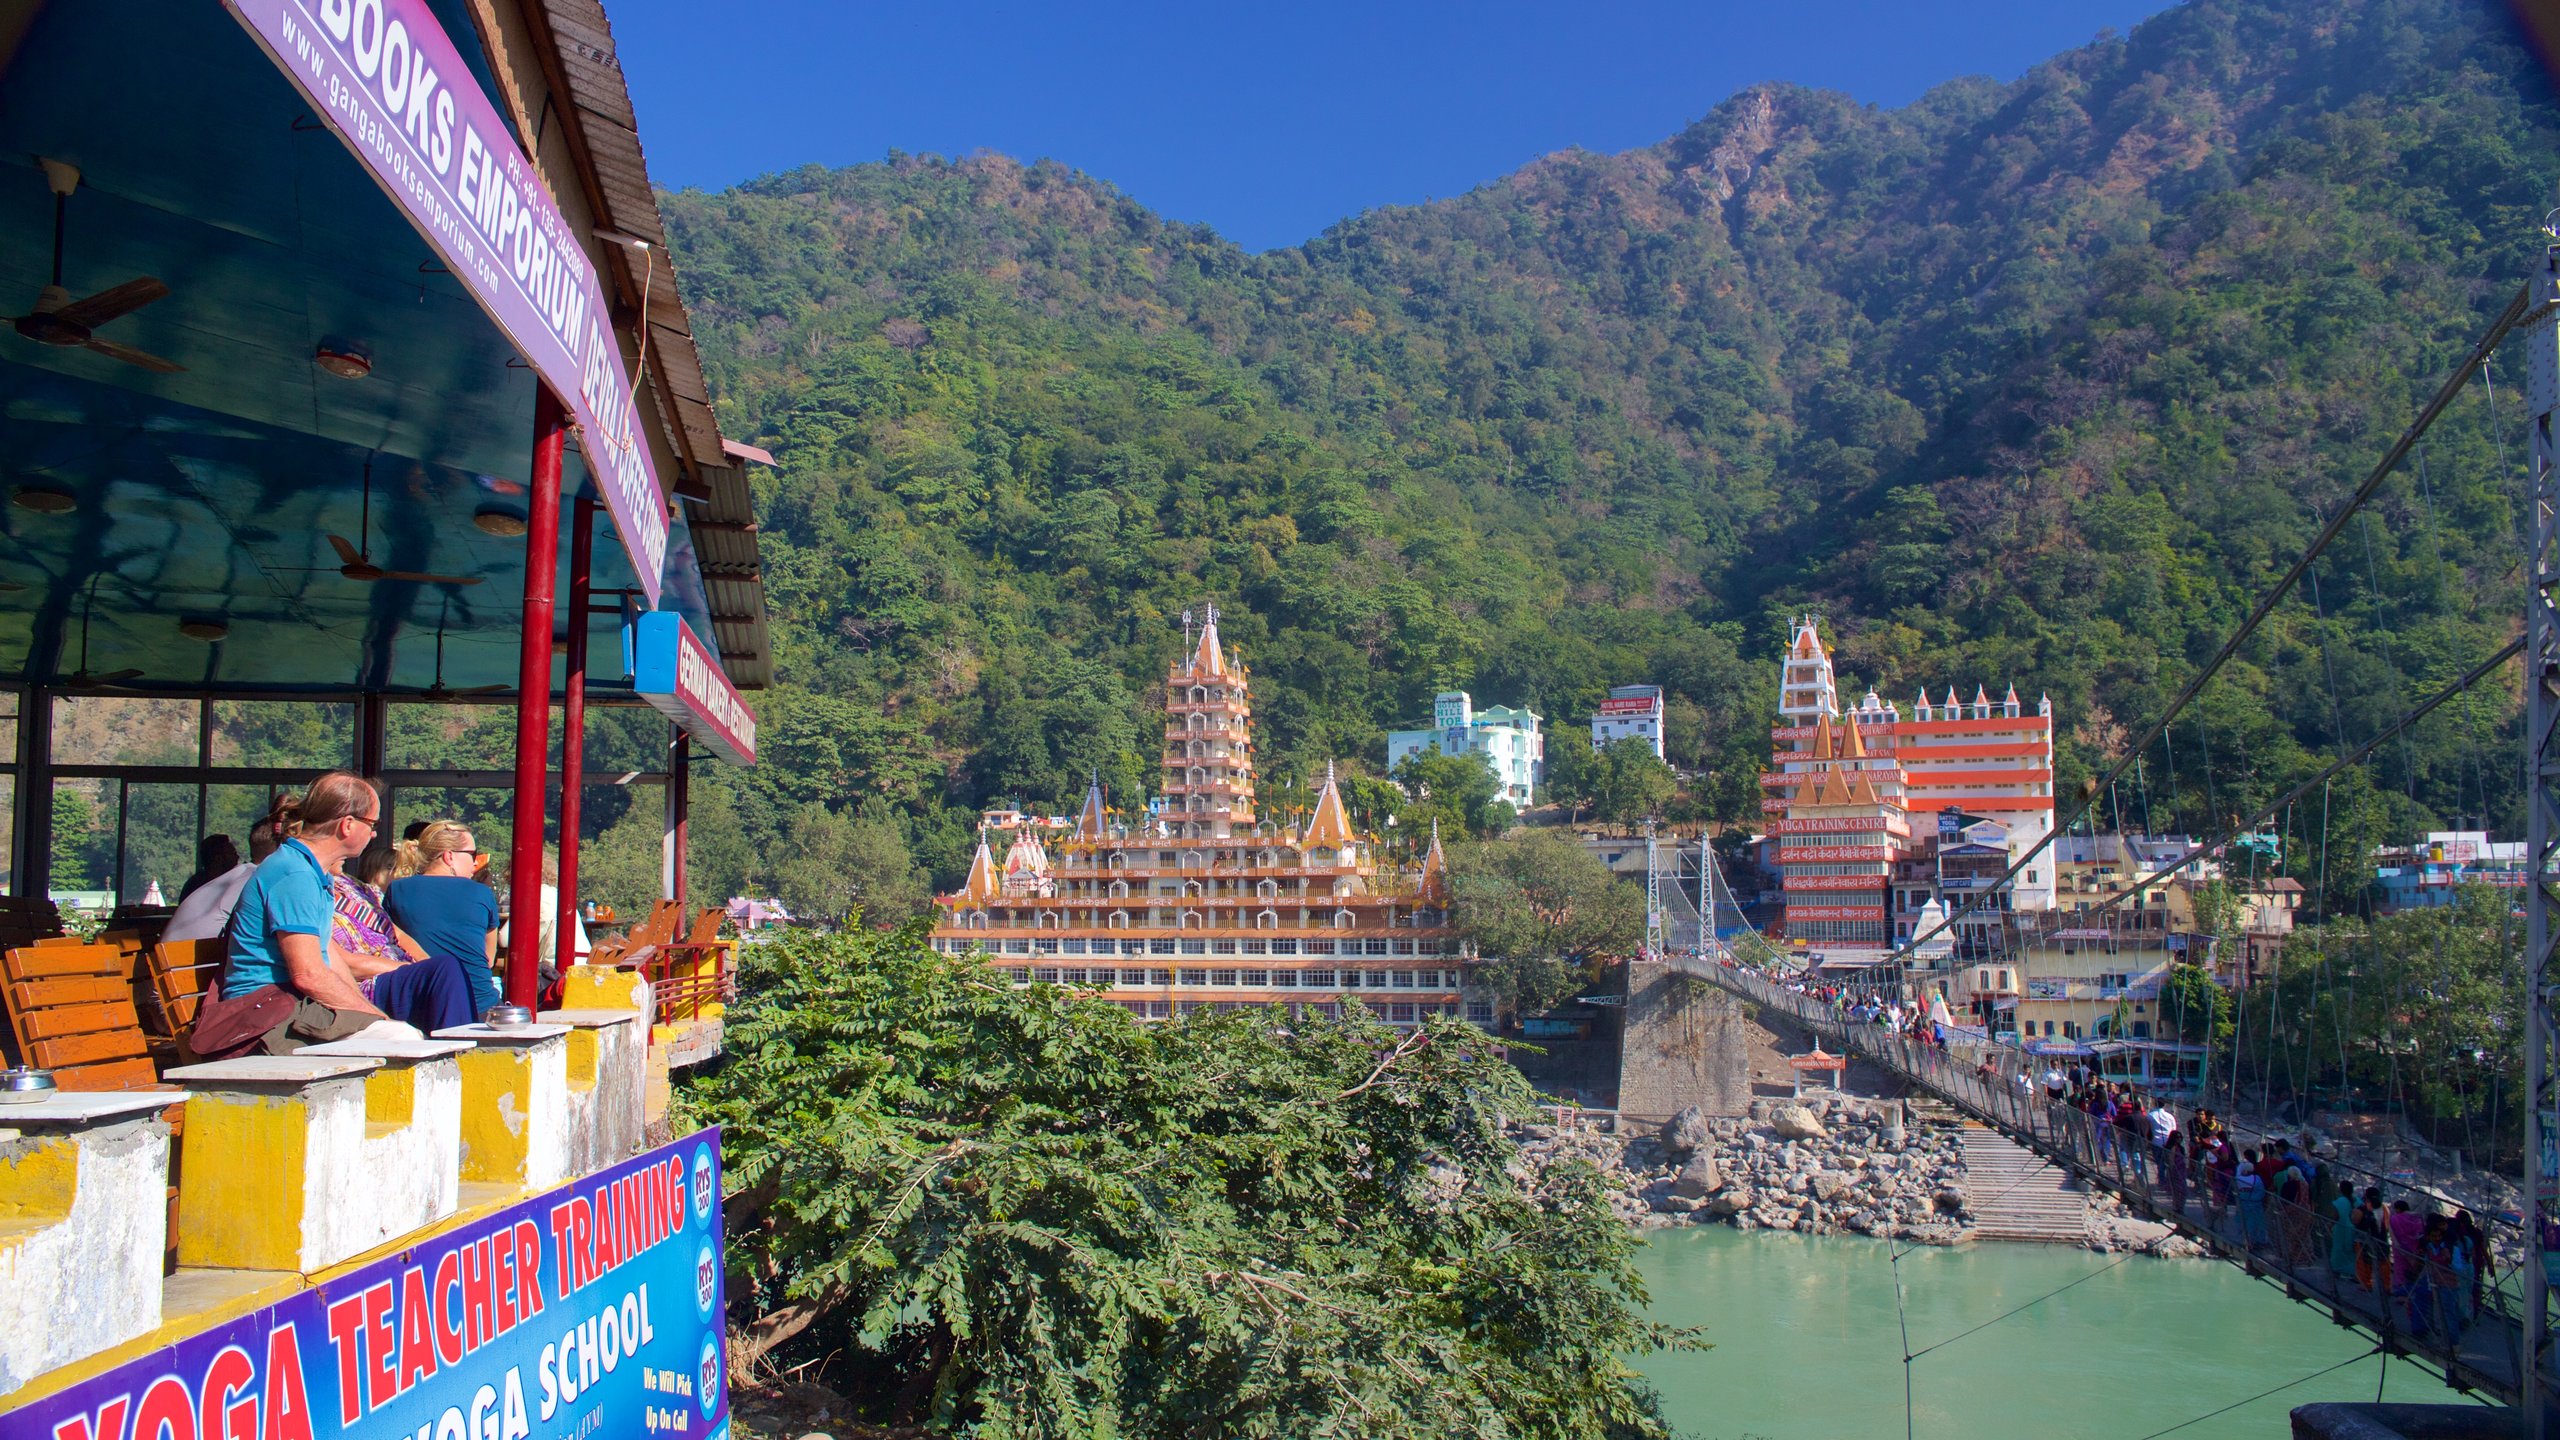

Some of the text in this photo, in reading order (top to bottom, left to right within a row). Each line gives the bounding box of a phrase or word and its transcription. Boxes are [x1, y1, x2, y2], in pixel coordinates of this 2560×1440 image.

[282, 9, 499, 294] www.gangabooksemporium.com
[508, 151, 523, 190] PH:
[457, 123, 586, 356] EMPORIUM
[617, 415, 649, 537] COFFEE
[641, 487, 667, 586] CORNER
[679, 635, 708, 708] GERMAN
[707, 668, 729, 728] BAKERY
[1437, 701, 1461, 709] HOTEL
[1437, 708, 1462, 717] HILL
[1439, 716, 1461, 727] TOP
[1779, 819, 1804, 831] YOGA
[1805, 818, 1850, 831] TRAINING
[1850, 817, 1886, 829] CENTRE
[1781, 850, 1800, 860] दर्शन
[695, 1166, 711, 1196] RYS
[698, 1192, 710, 1212] 200
[698, 1258, 714, 1291] RYS
[53, 1152, 687, 1440] GA TEACHER TRAINING
[701, 1284, 713, 1306] 300
[402, 1281, 655, 1440] GA SCHOOL
[702, 1353, 717, 1388] RYS
[643, 1366, 692, 1397] We Will Pick
[705, 1381, 717, 1403] 500
[646, 1405, 688, 1435] Up On Call
